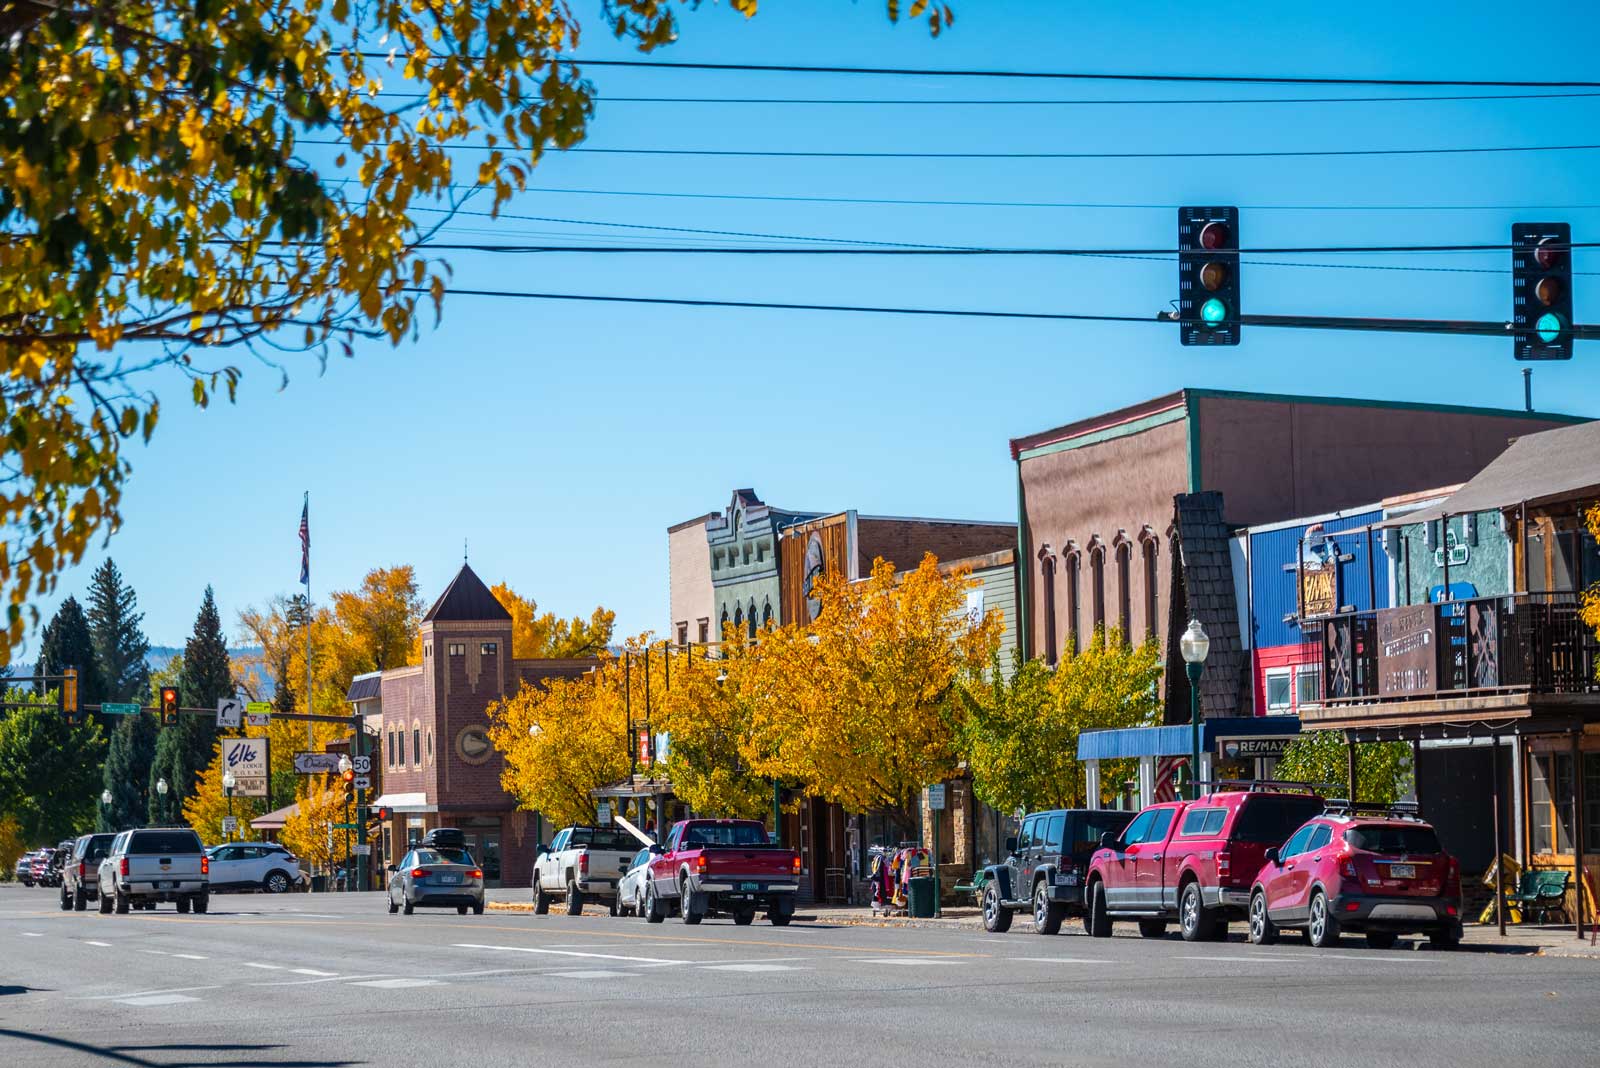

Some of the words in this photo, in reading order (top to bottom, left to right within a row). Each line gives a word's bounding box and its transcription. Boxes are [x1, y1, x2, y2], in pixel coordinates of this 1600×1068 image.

[1303, 571, 1334, 604] E/MAX
[219, 718, 236, 726] ONLY
[1240, 741, 1286, 752] RE/MAX
[227, 742, 257, 767] Elks
[355, 758, 369, 770] 50
